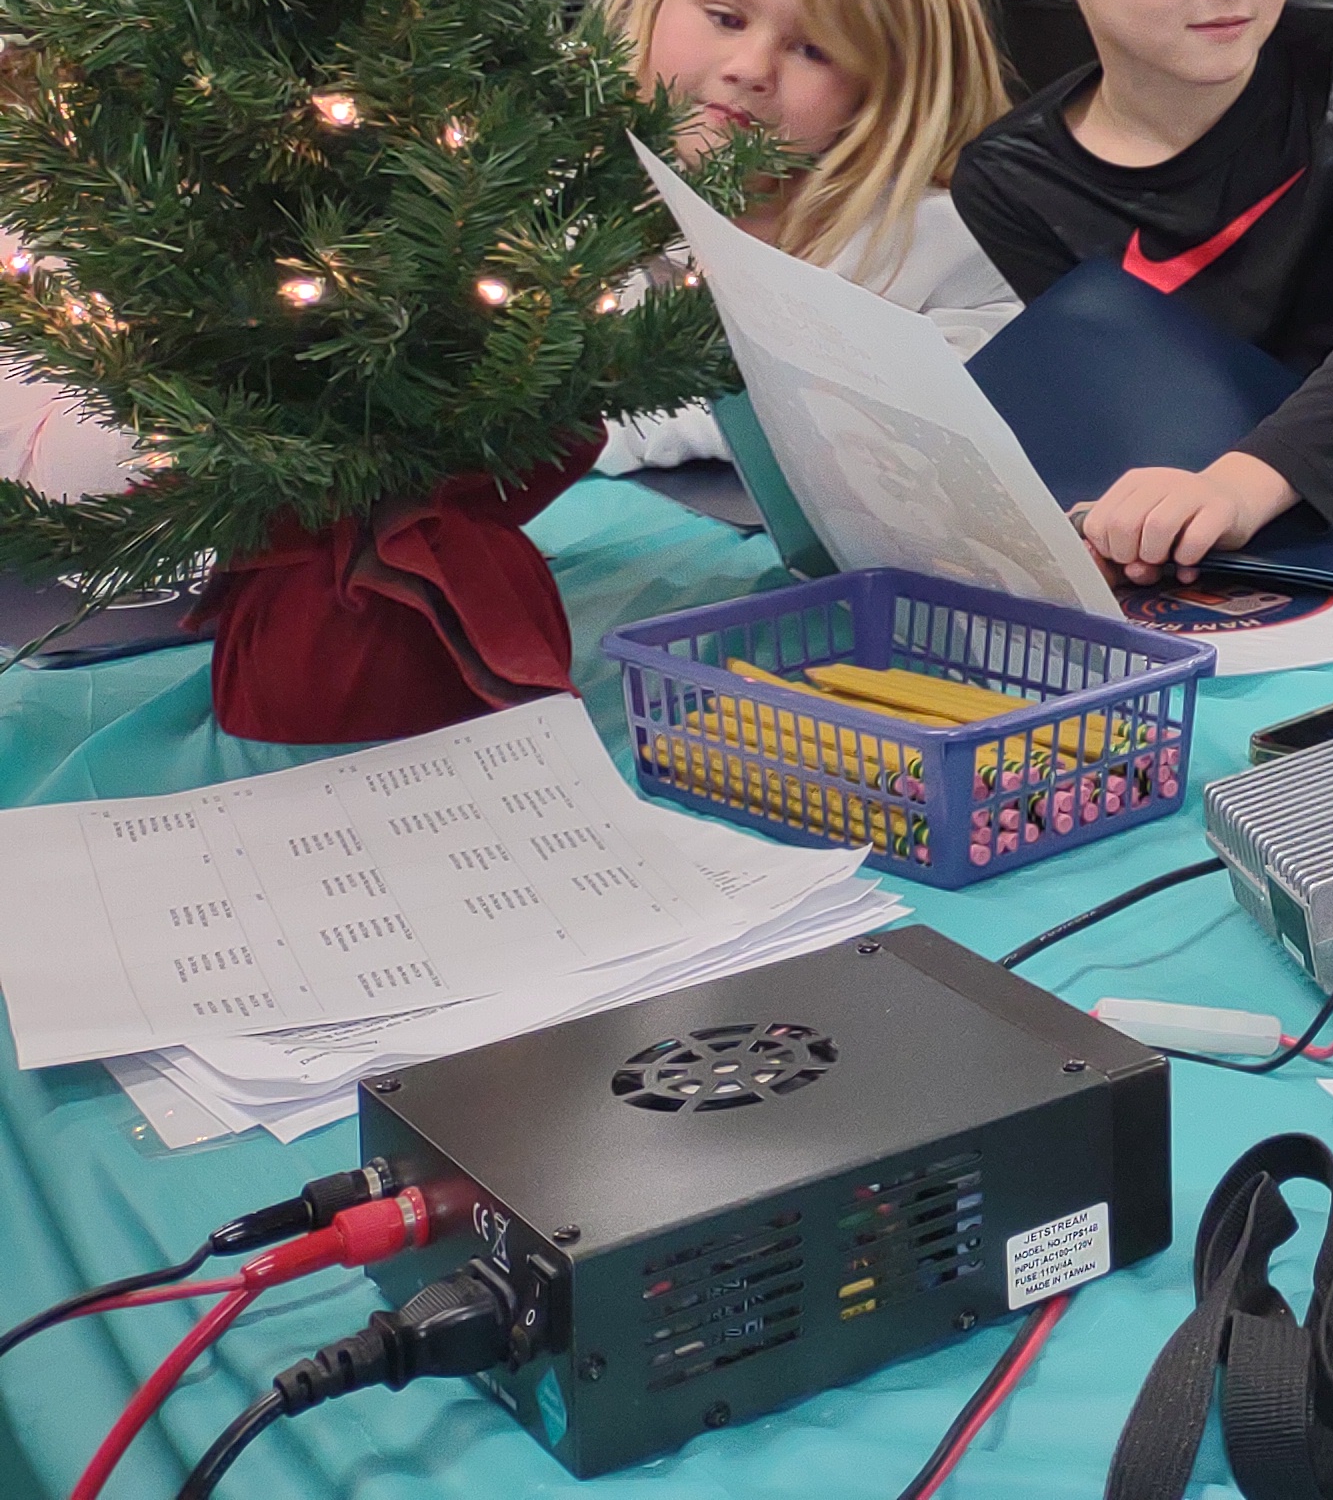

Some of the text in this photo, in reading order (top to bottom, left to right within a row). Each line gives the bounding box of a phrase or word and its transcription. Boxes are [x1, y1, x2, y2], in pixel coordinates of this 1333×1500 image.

[1192, 618, 1262, 632] HAM
[1024, 1212, 1088, 1244] JETSTREAM
[1014, 1245, 1045, 1262] MODEL
[1025, 1261, 1096, 1295] MADE IN TAIWAN
